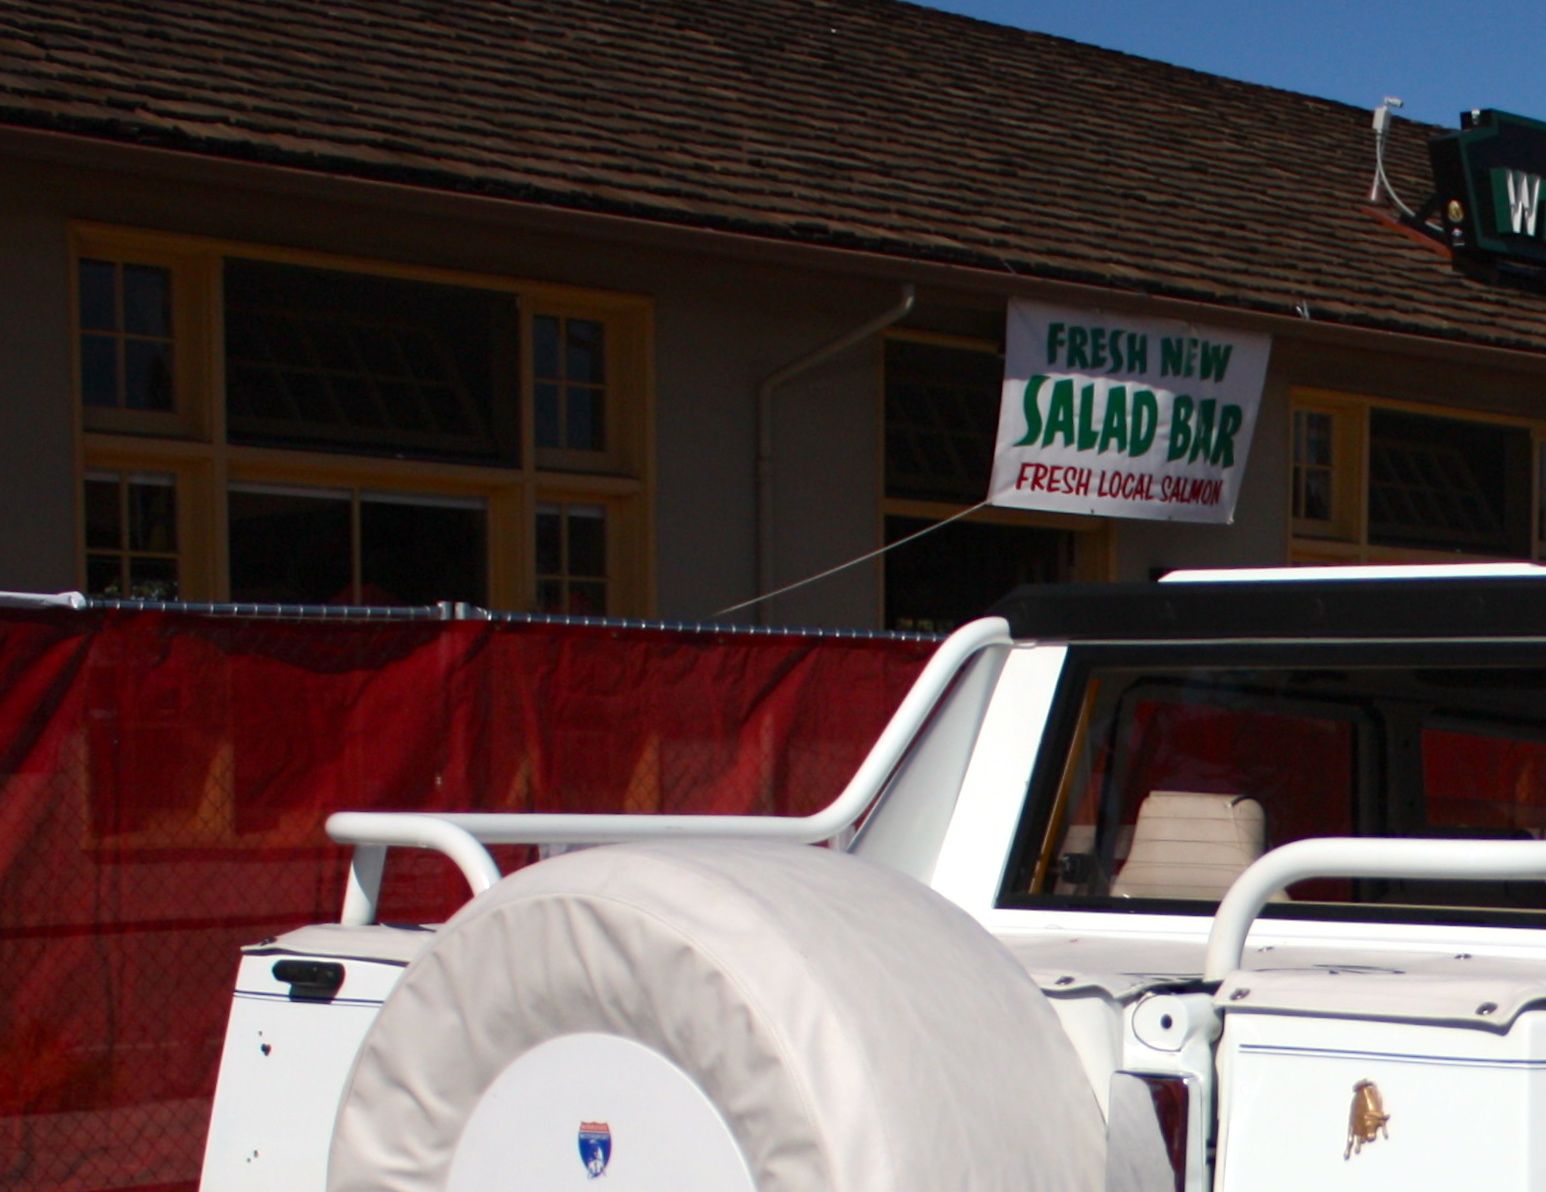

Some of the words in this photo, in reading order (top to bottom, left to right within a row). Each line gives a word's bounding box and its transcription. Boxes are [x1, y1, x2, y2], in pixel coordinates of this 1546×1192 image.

[1047, 322, 1148, 375] FRESH
[1160, 336, 1233, 383] NEW
[1012, 375, 1158, 458] SALAD
[1167, 395, 1243, 469] BAR
[1015, 462, 1092, 497] FRESH
[1097, 470, 1152, 501] LOCAL
[1159, 475, 1224, 507] SALMON
